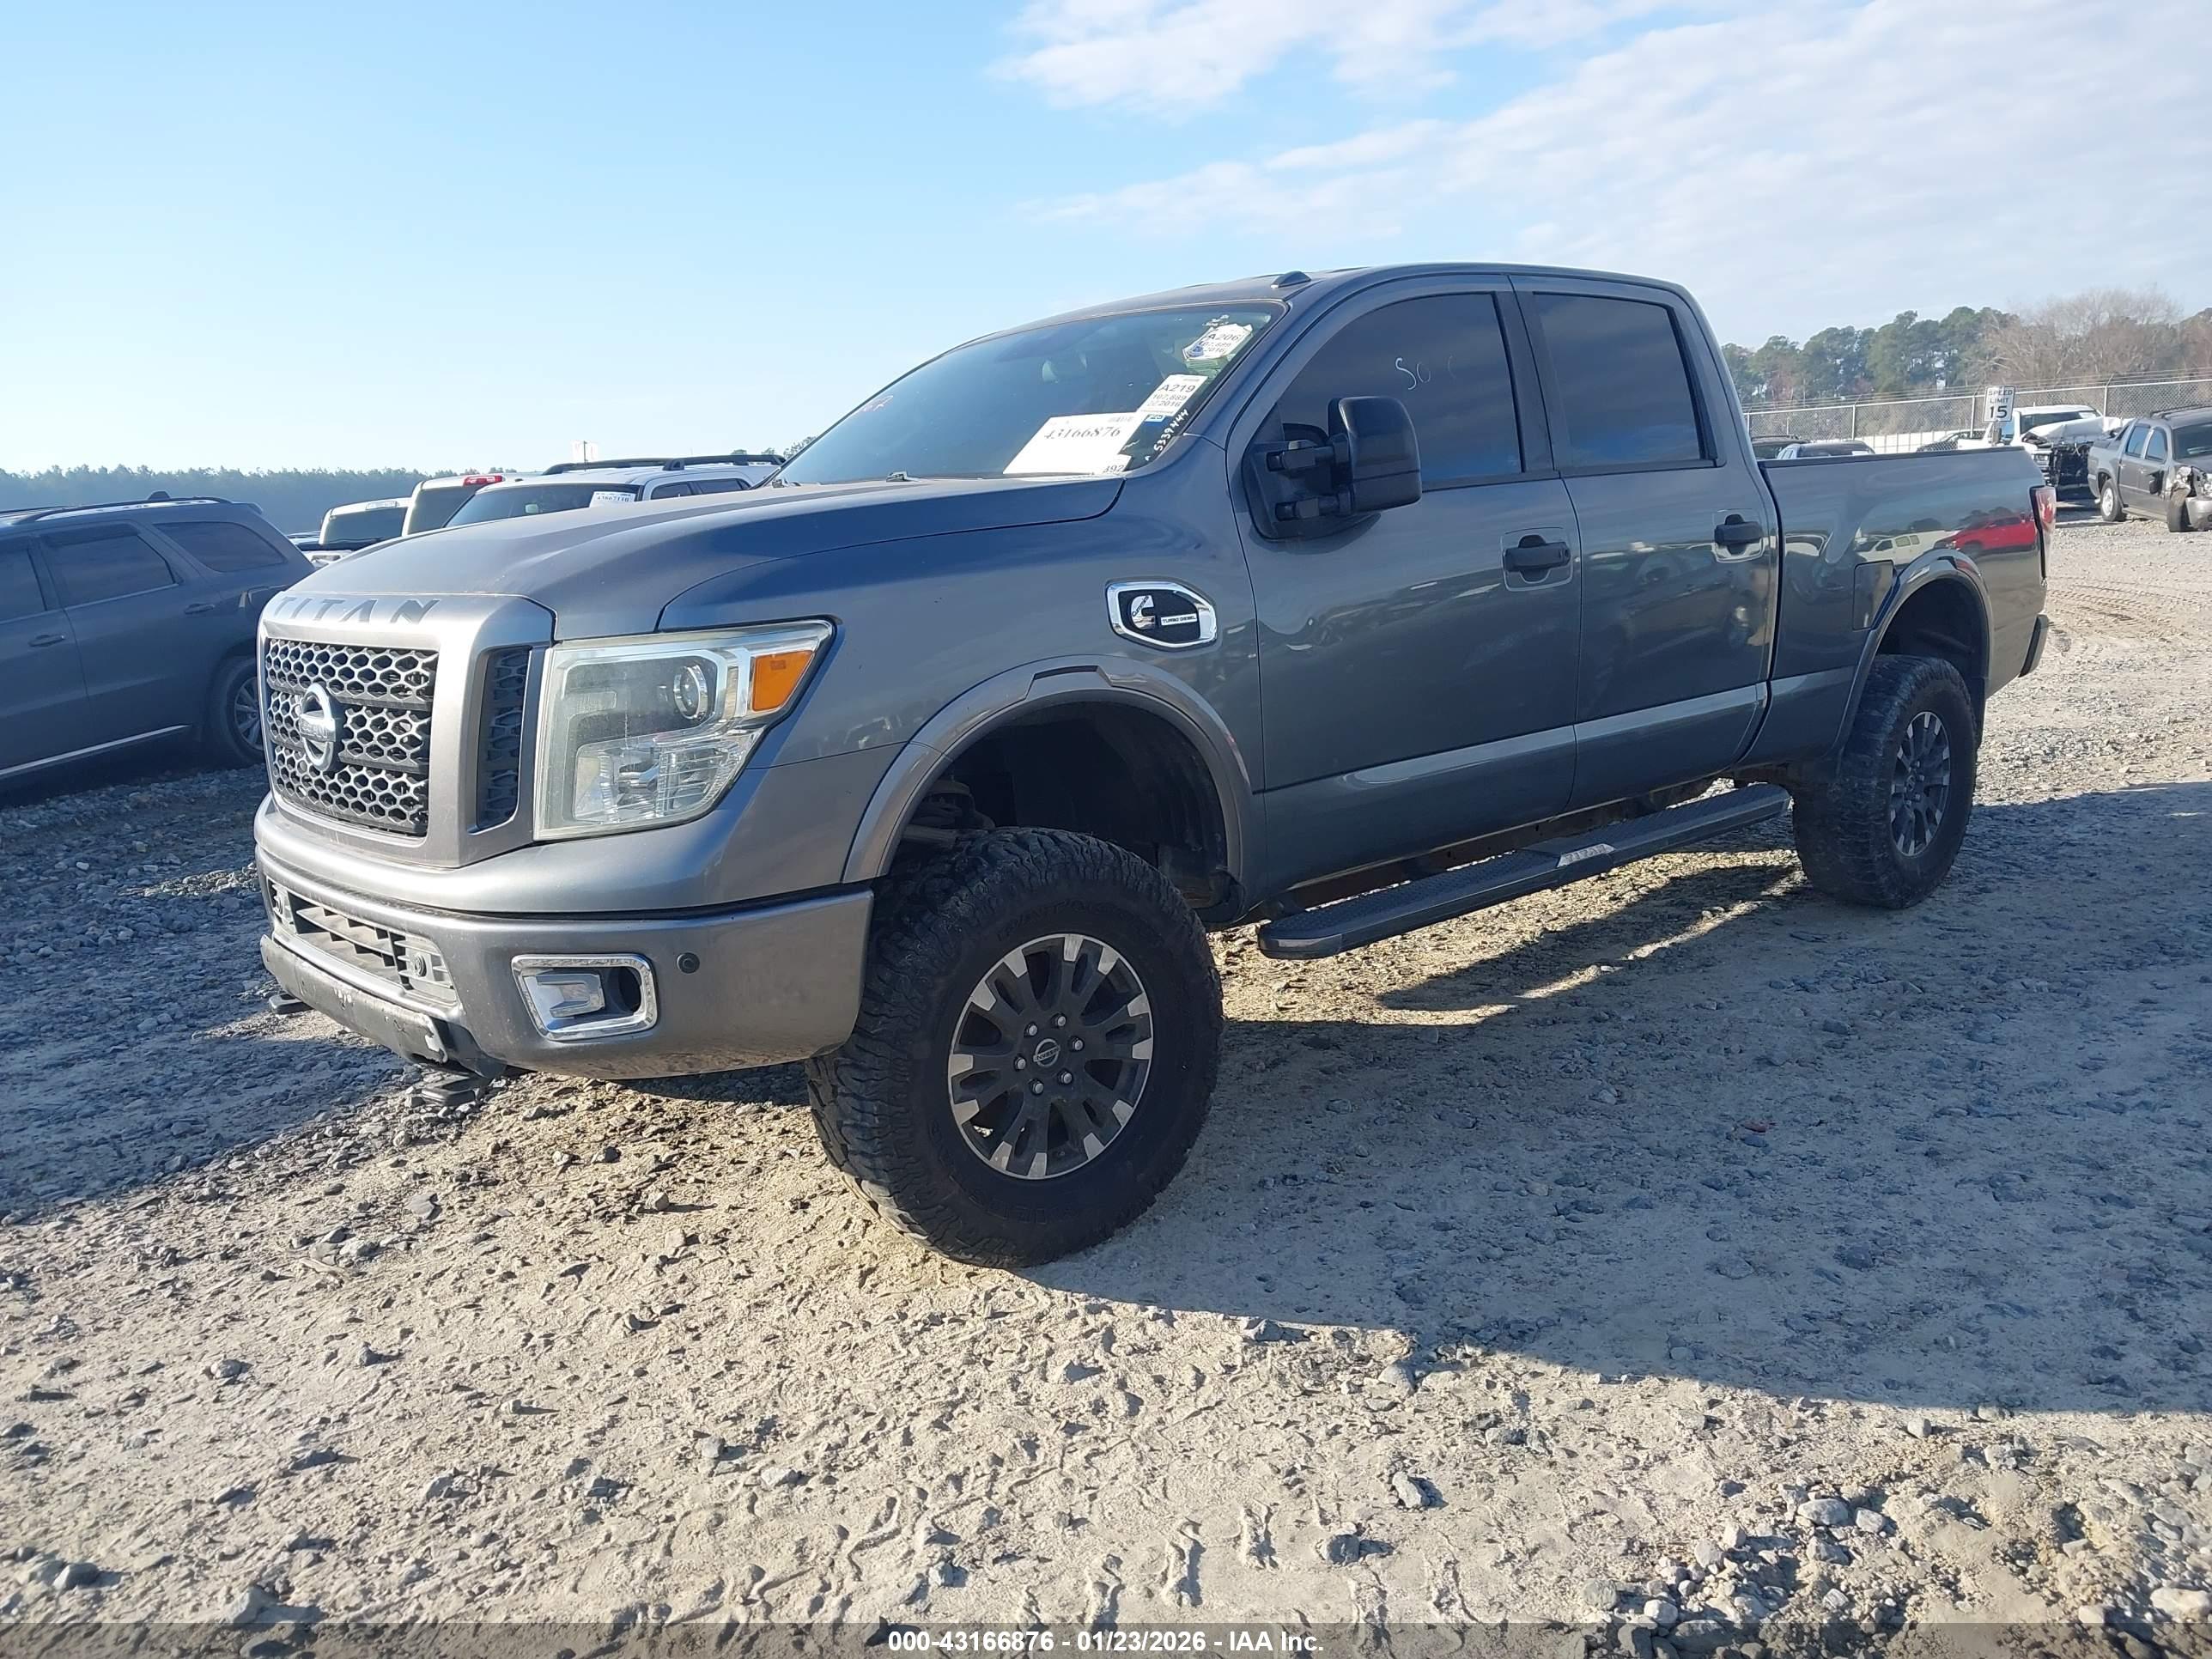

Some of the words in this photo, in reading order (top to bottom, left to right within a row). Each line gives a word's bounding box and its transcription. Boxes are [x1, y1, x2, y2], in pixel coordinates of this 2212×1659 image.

[1208, 333, 1241, 342] A206
[1158, 384, 1196, 392] A219
[1990, 405, 2008, 418] 15
[1043, 427, 1121, 440] 43166876
[274, 596, 441, 624] TITAN
